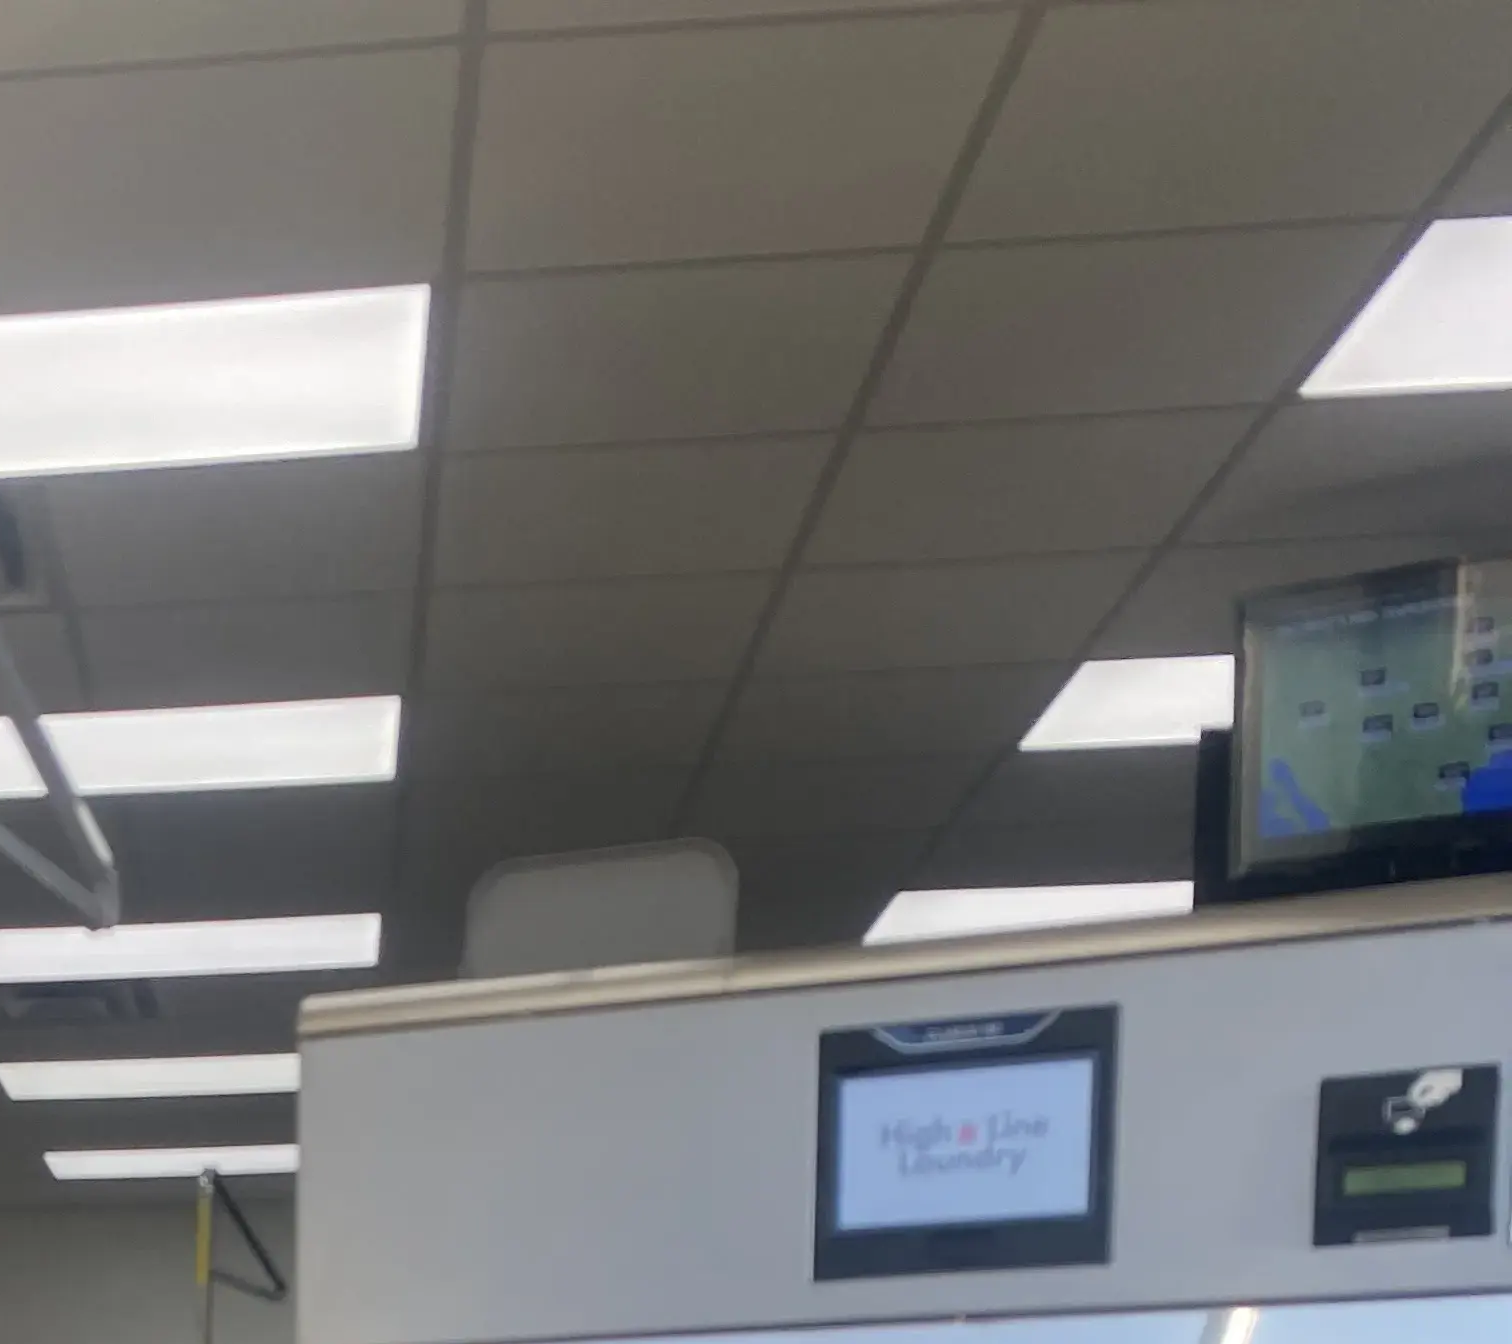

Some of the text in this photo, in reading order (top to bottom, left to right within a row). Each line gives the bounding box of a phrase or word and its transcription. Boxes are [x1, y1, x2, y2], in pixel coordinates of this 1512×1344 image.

[880, 1110, 1049, 1150] High Line
[897, 1146, 1027, 1178] Laundry
